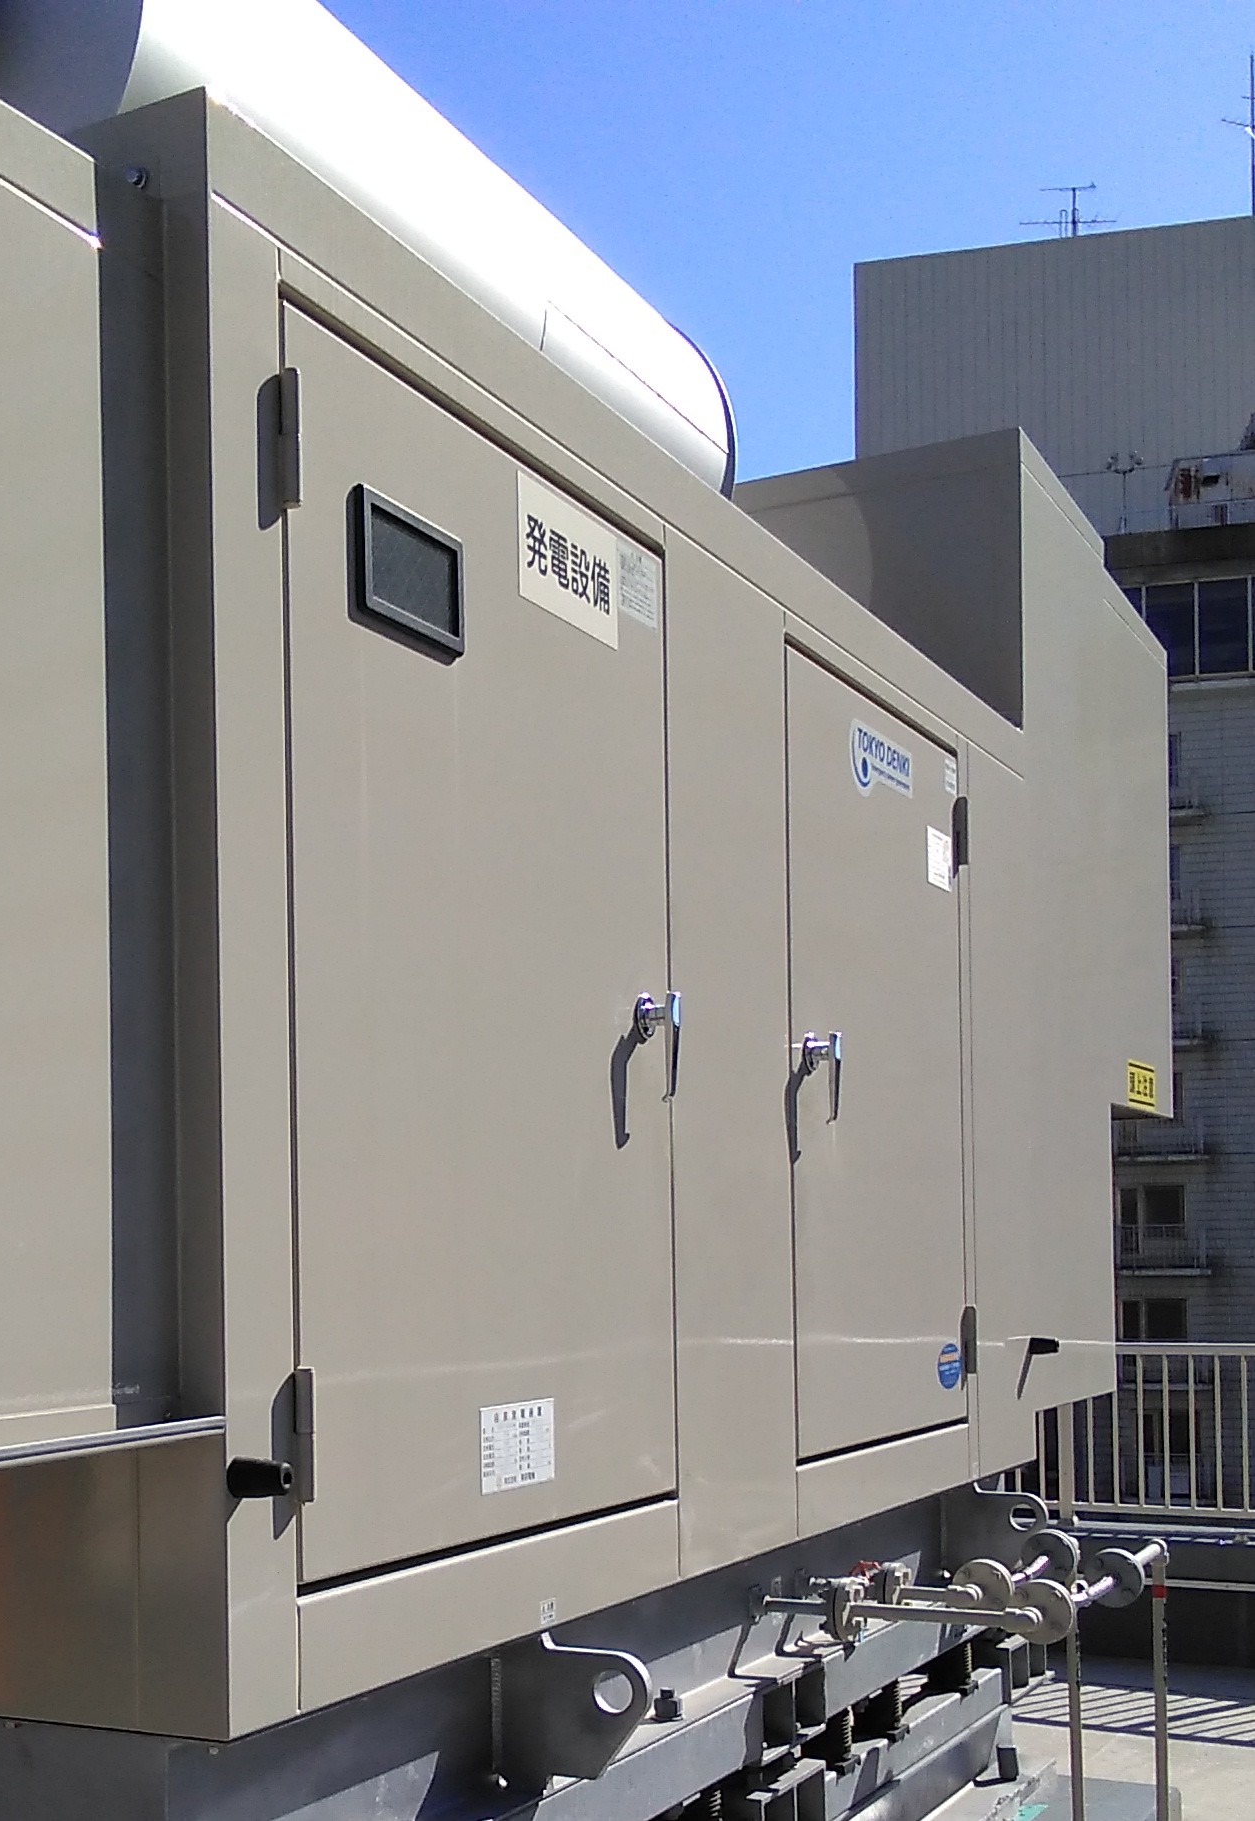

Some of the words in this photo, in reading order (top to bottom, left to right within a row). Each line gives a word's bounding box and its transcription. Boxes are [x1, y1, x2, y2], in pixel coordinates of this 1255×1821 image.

[526, 514, 610, 615] 発電設備
[857, 727, 885, 762] TOKYO
[886, 745, 910, 777] DENKI
